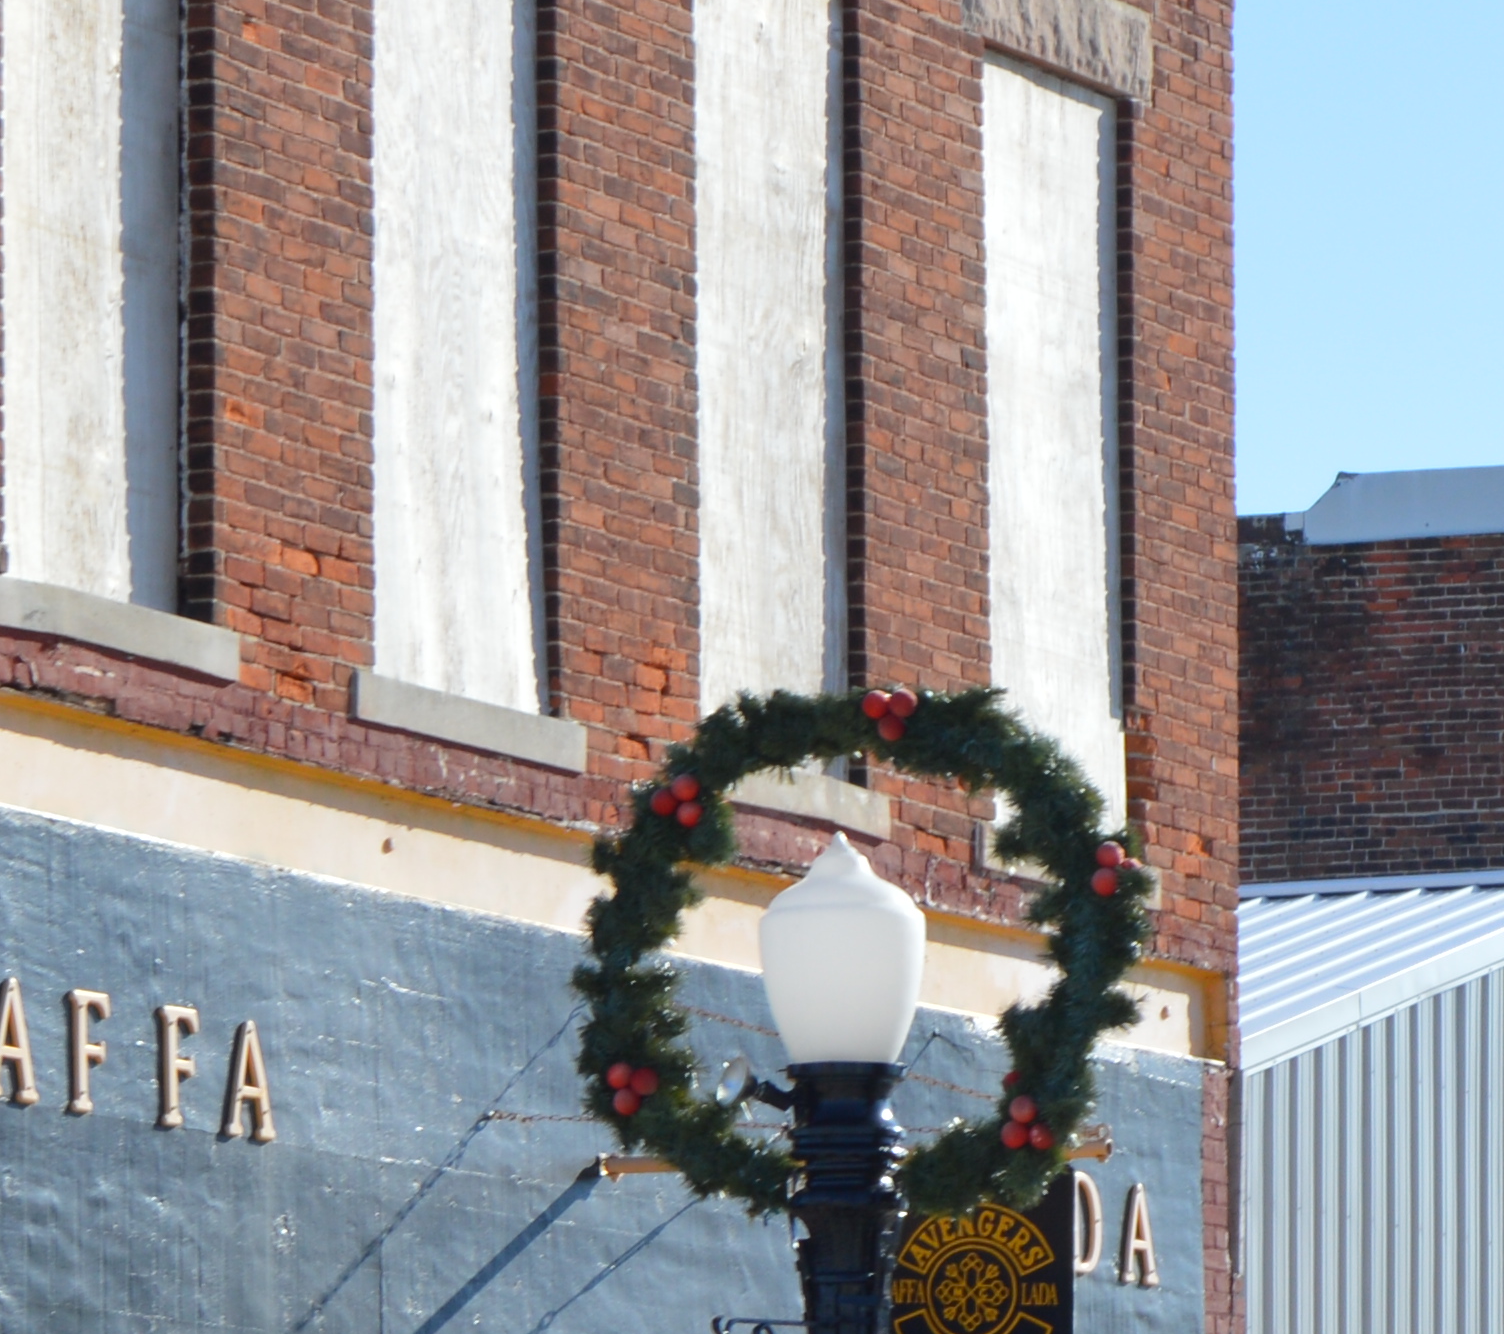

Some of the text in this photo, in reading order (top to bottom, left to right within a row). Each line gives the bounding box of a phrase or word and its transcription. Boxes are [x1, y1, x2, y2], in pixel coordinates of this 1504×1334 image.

[910, 1209, 1045, 1268] AVENGERS
[1073, 1170, 1160, 1287] DA
[1021, 1281, 1059, 1306] LADA
